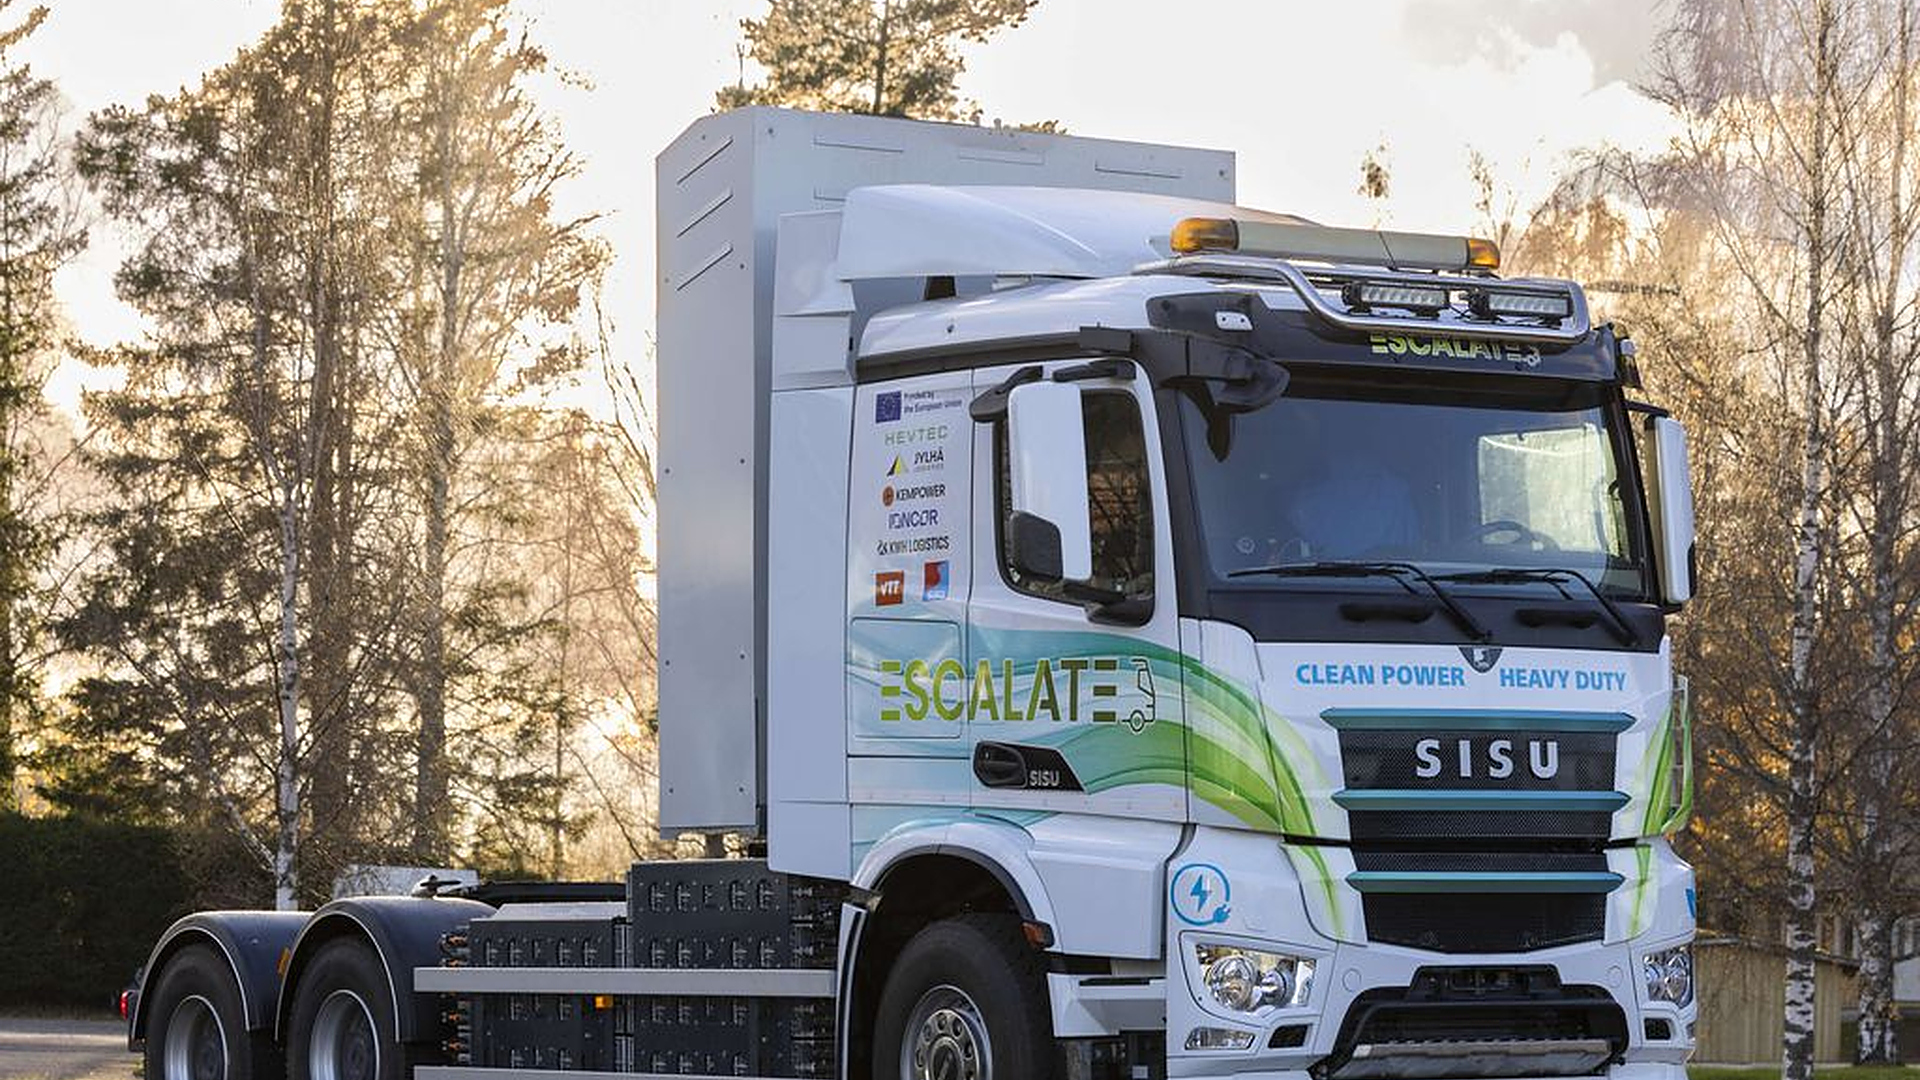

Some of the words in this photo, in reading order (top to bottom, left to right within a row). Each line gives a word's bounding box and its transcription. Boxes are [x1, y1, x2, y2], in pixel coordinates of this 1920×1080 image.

[1370, 333, 1522, 362] ESCALATE
[884, 425, 948, 446] HEVTEC
[896, 484, 946, 501] KEMPOWER
[908, 535, 950, 553] LOGISTICS
[880, 580, 900, 596] VTT
[1296, 664, 1375, 686] CLEAN
[1382, 665, 1466, 687] POWER
[1499, 668, 1569, 690] HEAVY
[1575, 670, 1626, 692] DUTY
[880, 658, 1118, 722] ESCALATE
[1415, 738, 1560, 779] SISU
[1029, 769, 1061, 787] SISU
